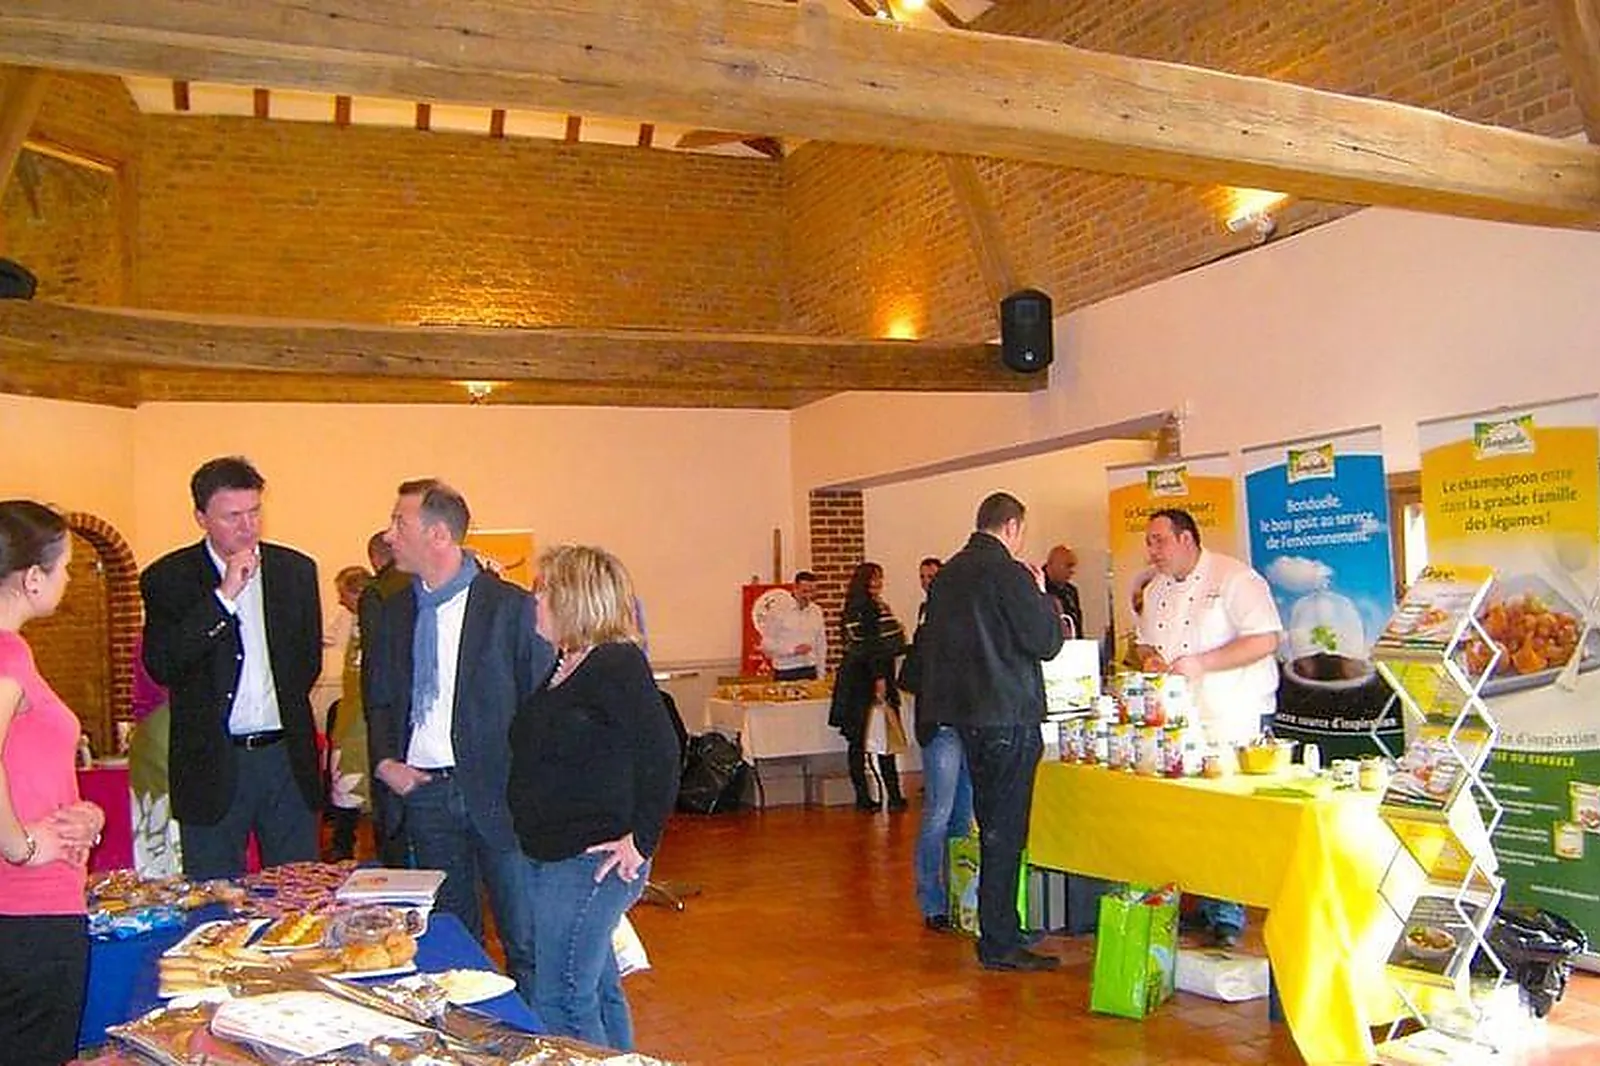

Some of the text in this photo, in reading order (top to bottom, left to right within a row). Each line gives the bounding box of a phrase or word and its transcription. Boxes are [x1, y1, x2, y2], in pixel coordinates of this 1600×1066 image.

[1443, 480, 1457, 494] Le
[1458, 473, 1538, 492] champignon
[1468, 496, 1481, 510] la
[1483, 491, 1530, 512] grande
[1532, 486, 1579, 504] famille
[1464, 516, 1487, 531] des
